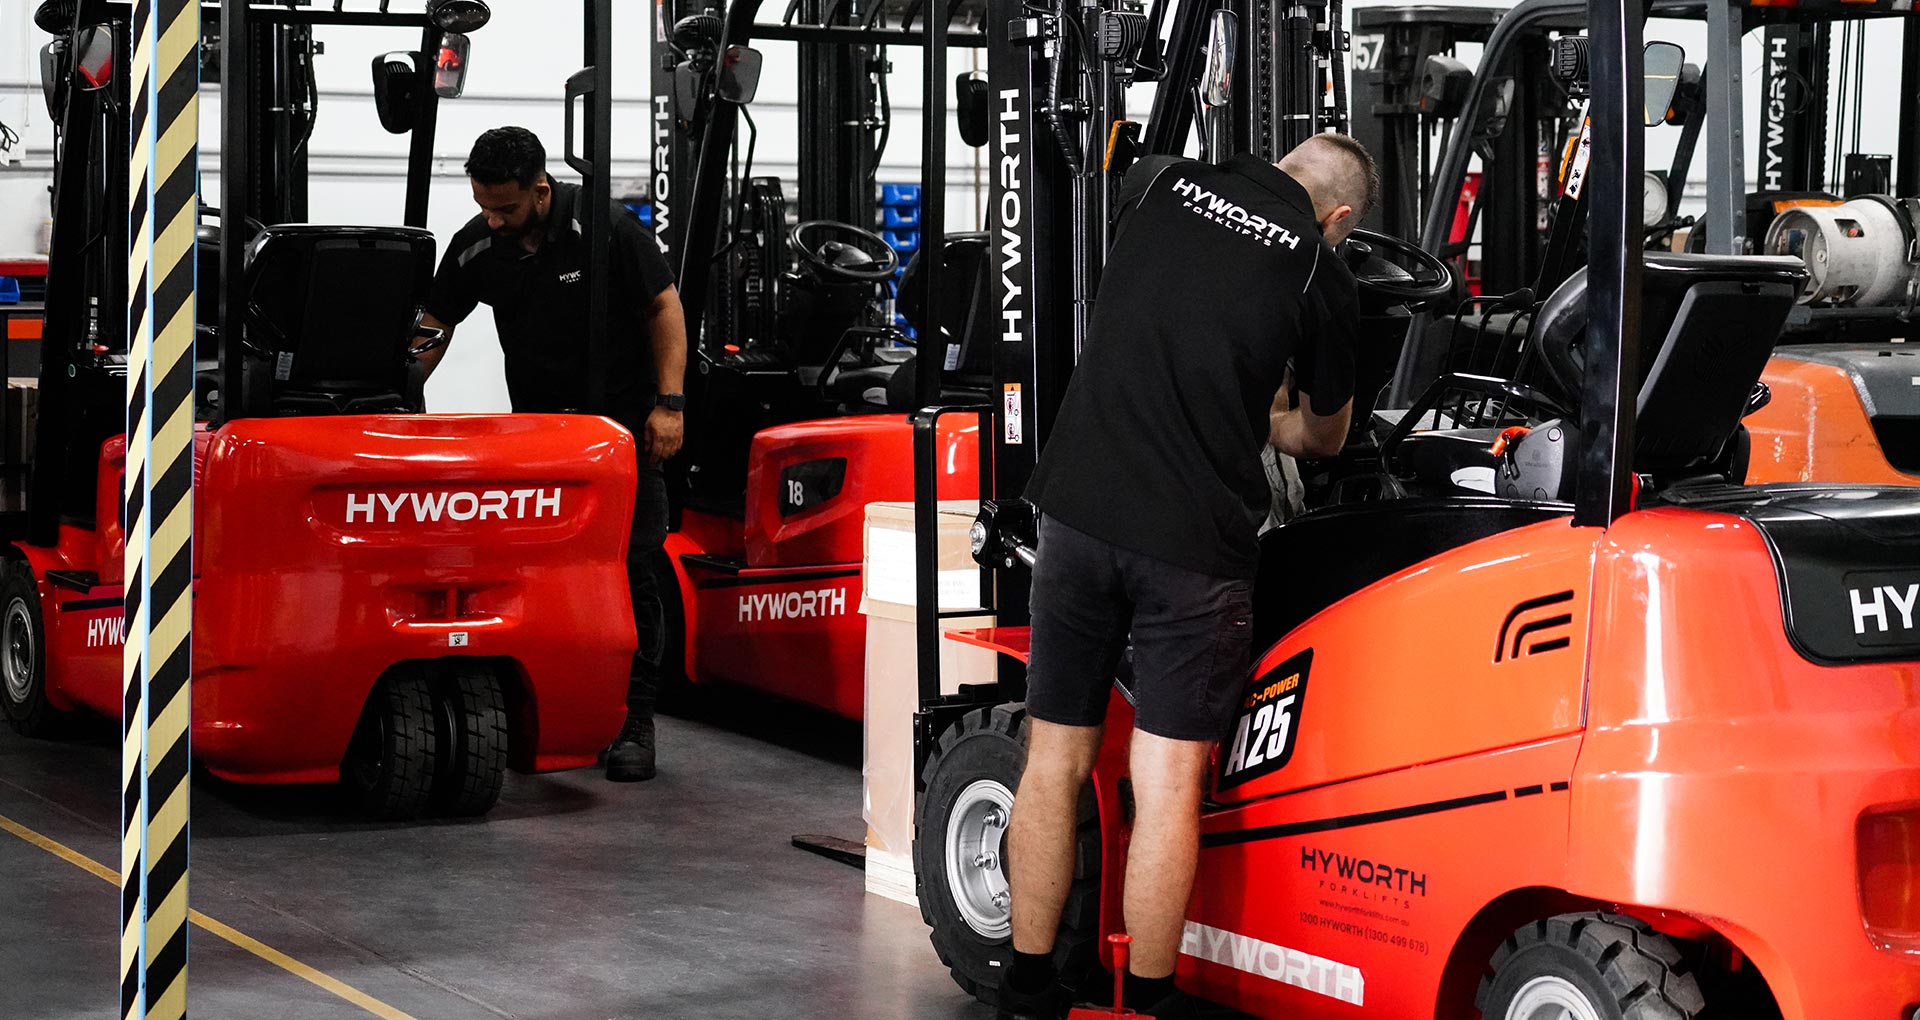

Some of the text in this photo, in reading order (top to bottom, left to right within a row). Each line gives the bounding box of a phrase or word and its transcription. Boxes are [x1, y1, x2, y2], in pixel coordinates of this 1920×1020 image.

[1765, 38, 1787, 190] HYWORTH
[1000, 88, 1022, 341] HYWORTH
[1172, 177, 1300, 250] HYWORTH
[1183, 201, 1272, 247] FORKLIFTS
[345, 487, 562, 523] HYWORTH
[788, 479, 804, 506] 18
[738, 587, 846, 622] HYWORTH
[1849, 583, 1920, 634] HY
[1225, 694, 1296, 777] A25
[1301, 846, 1426, 897] HYWORTH
[1319, 880, 1410, 909] FORKLIFTS
[1300, 911, 1319, 926] 1300
[1319, 917, 1364, 937] HYWORTH
[1364, 926, 1389, 944] (1300
[1180, 920, 1361, 1005] HYWORTH
